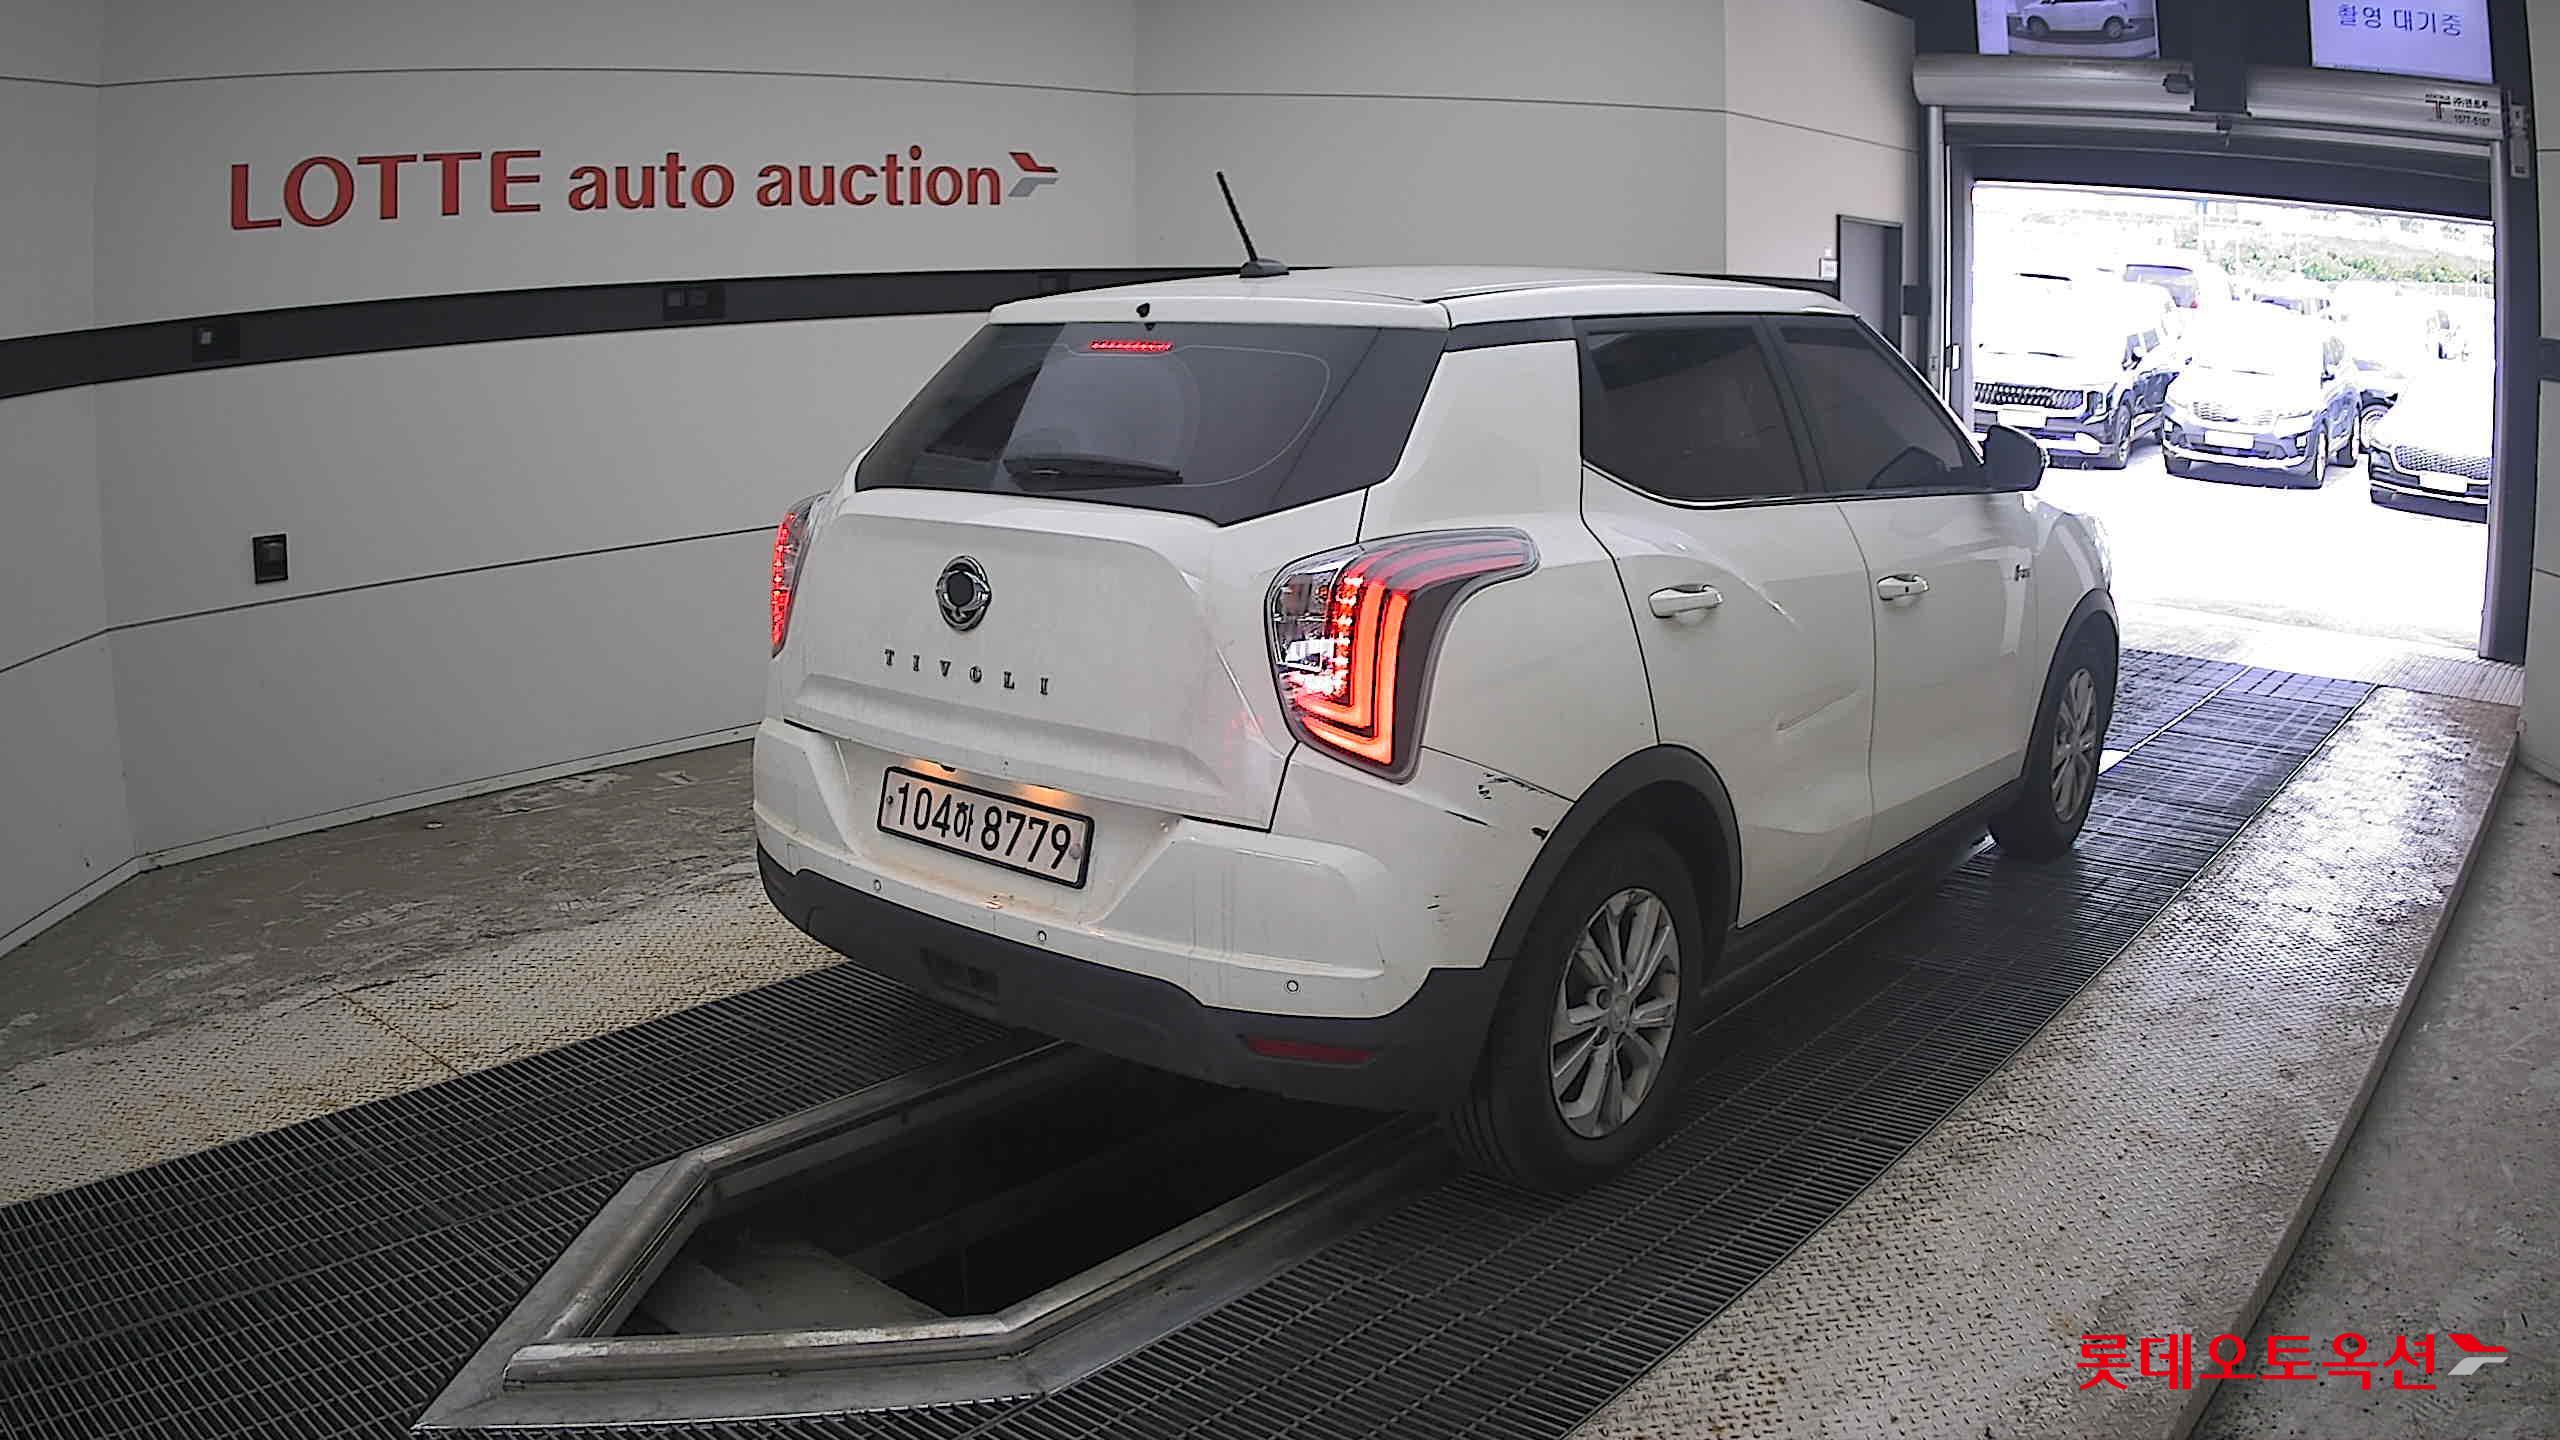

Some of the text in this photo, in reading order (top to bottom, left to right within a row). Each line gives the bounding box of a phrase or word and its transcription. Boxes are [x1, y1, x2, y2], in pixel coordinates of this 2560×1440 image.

[2338, 4, 2462, 36] 촬영 대기중
[231, 146, 1001, 230] LOTTE auto auction
[884, 648, 1049, 696] TIVOLI
[898, 782, 1071, 870] 104하 8779
